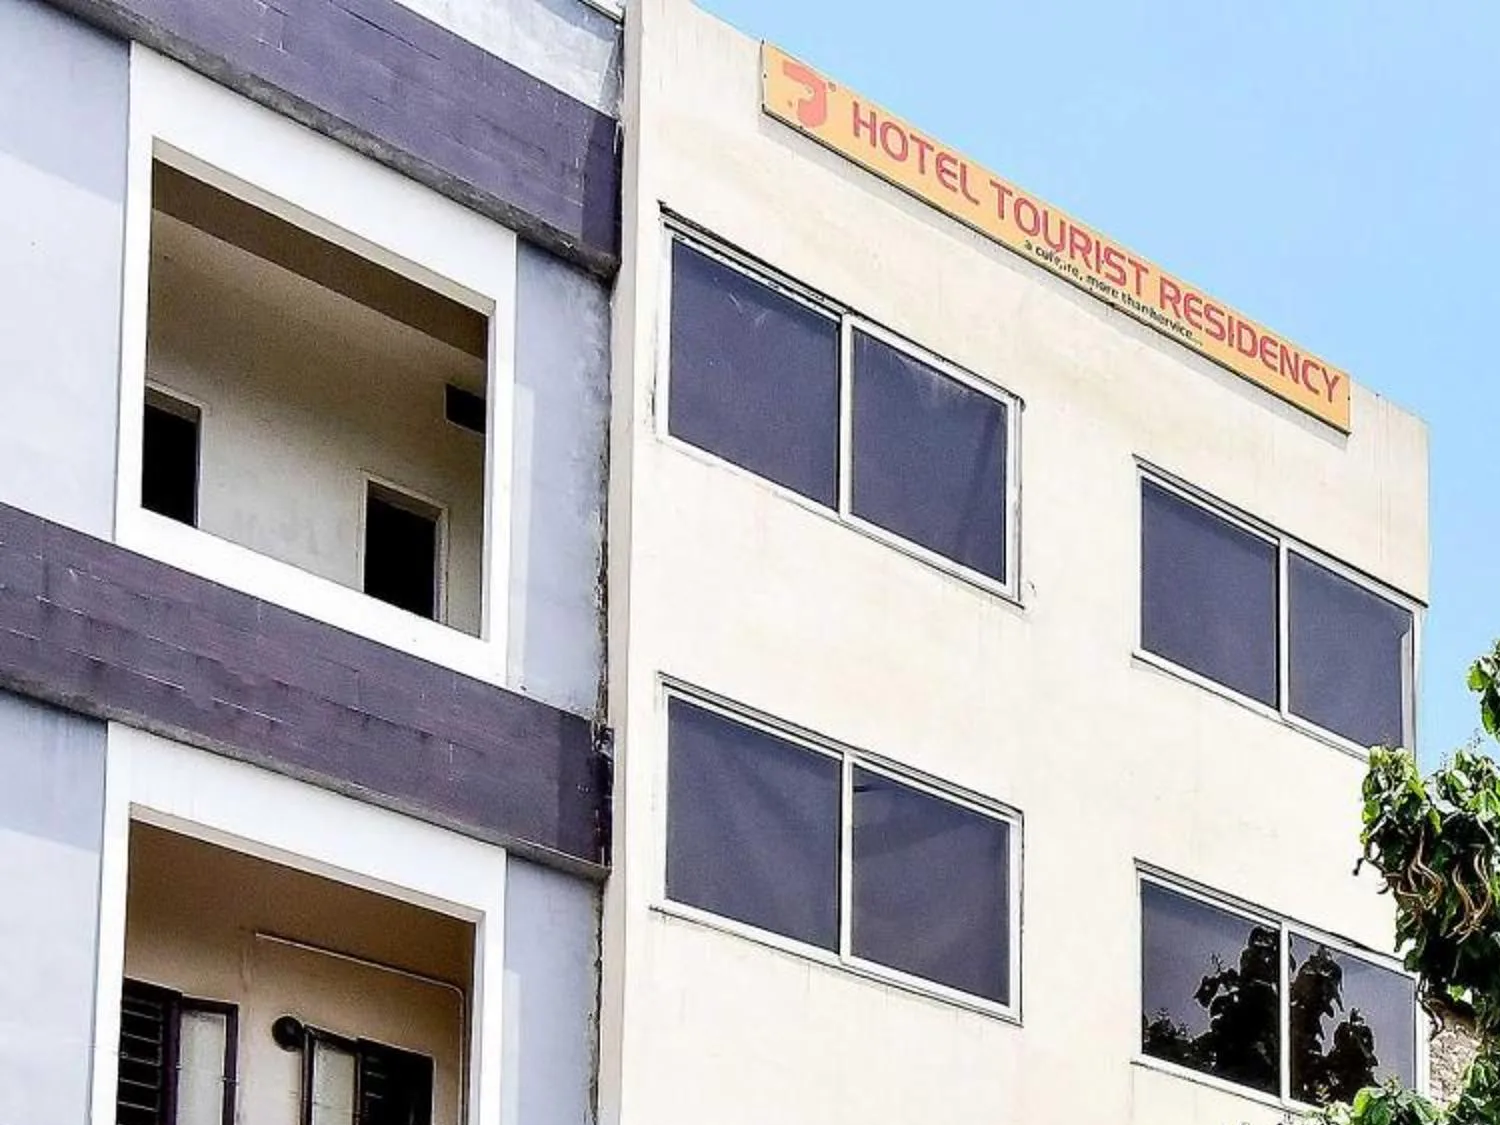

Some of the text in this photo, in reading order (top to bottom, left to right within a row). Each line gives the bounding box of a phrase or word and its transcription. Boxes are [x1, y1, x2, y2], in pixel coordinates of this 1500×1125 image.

[852, 101, 1342, 403] HOTEL TOURIST RESIDENCY
